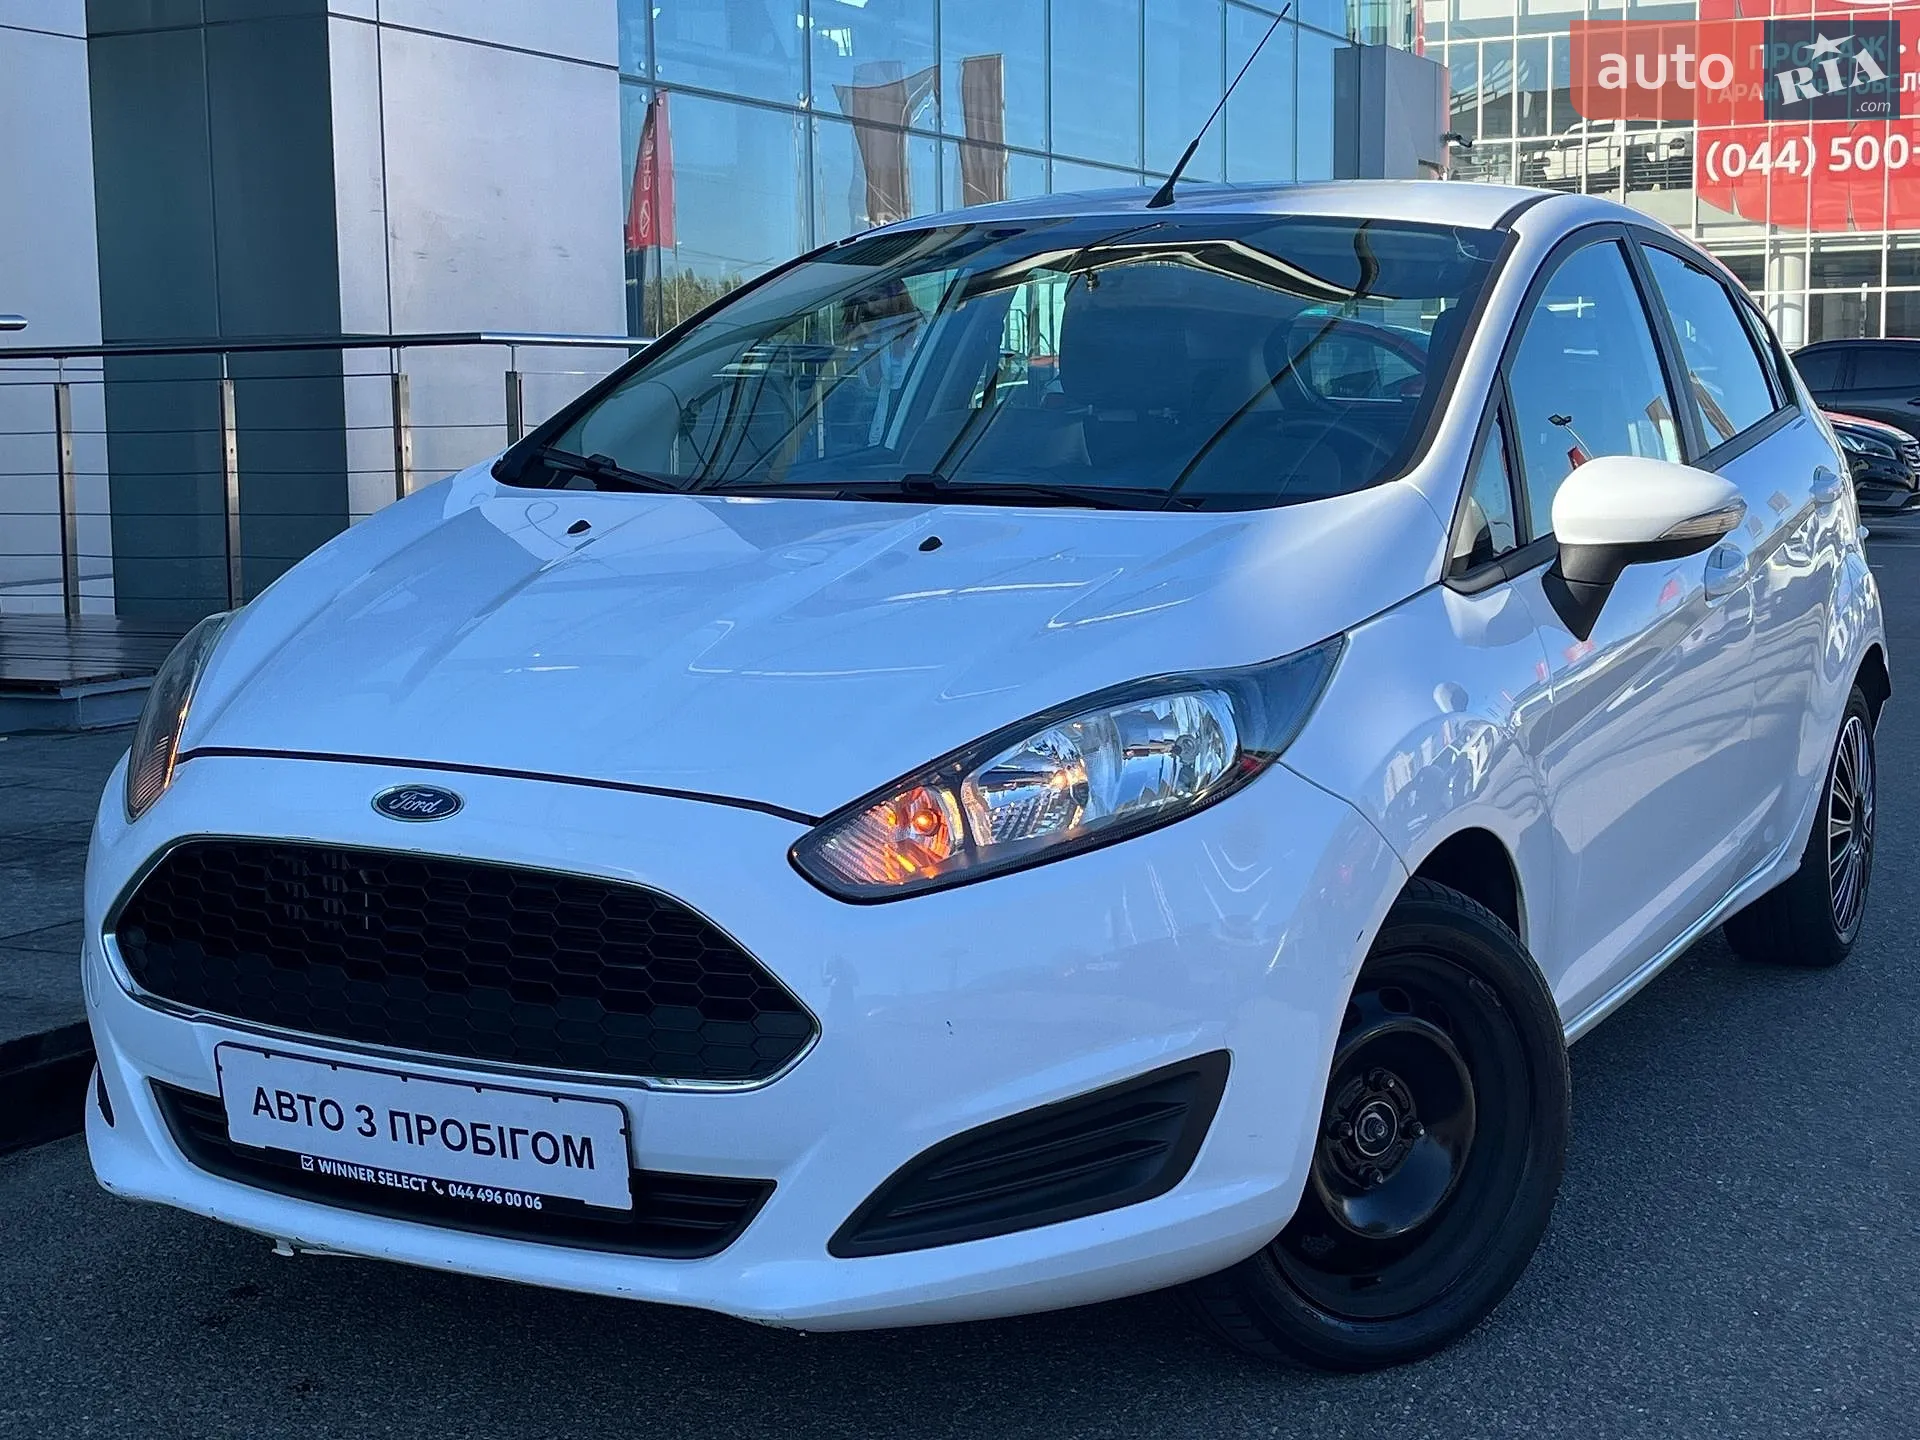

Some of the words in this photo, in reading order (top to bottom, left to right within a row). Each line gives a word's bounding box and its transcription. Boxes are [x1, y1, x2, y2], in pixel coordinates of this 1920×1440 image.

[1750, 35, 1886, 71] ПРОАЖ
[1705, 136, 1817, 182] (044)
[389, 790, 443, 814] Ford
[252, 1086, 345, 1132] АВТО
[389, 1110, 595, 1170] ПРОБІГОМ
[317, 1159, 376, 1183] WINNER
[378, 1172, 428, 1192] SELECT
[449, 1183, 474, 1200] 044
[476, 1188, 502, 1204] 496
[505, 1192, 522, 1208] 00
[524, 1195, 542, 1210] 06
